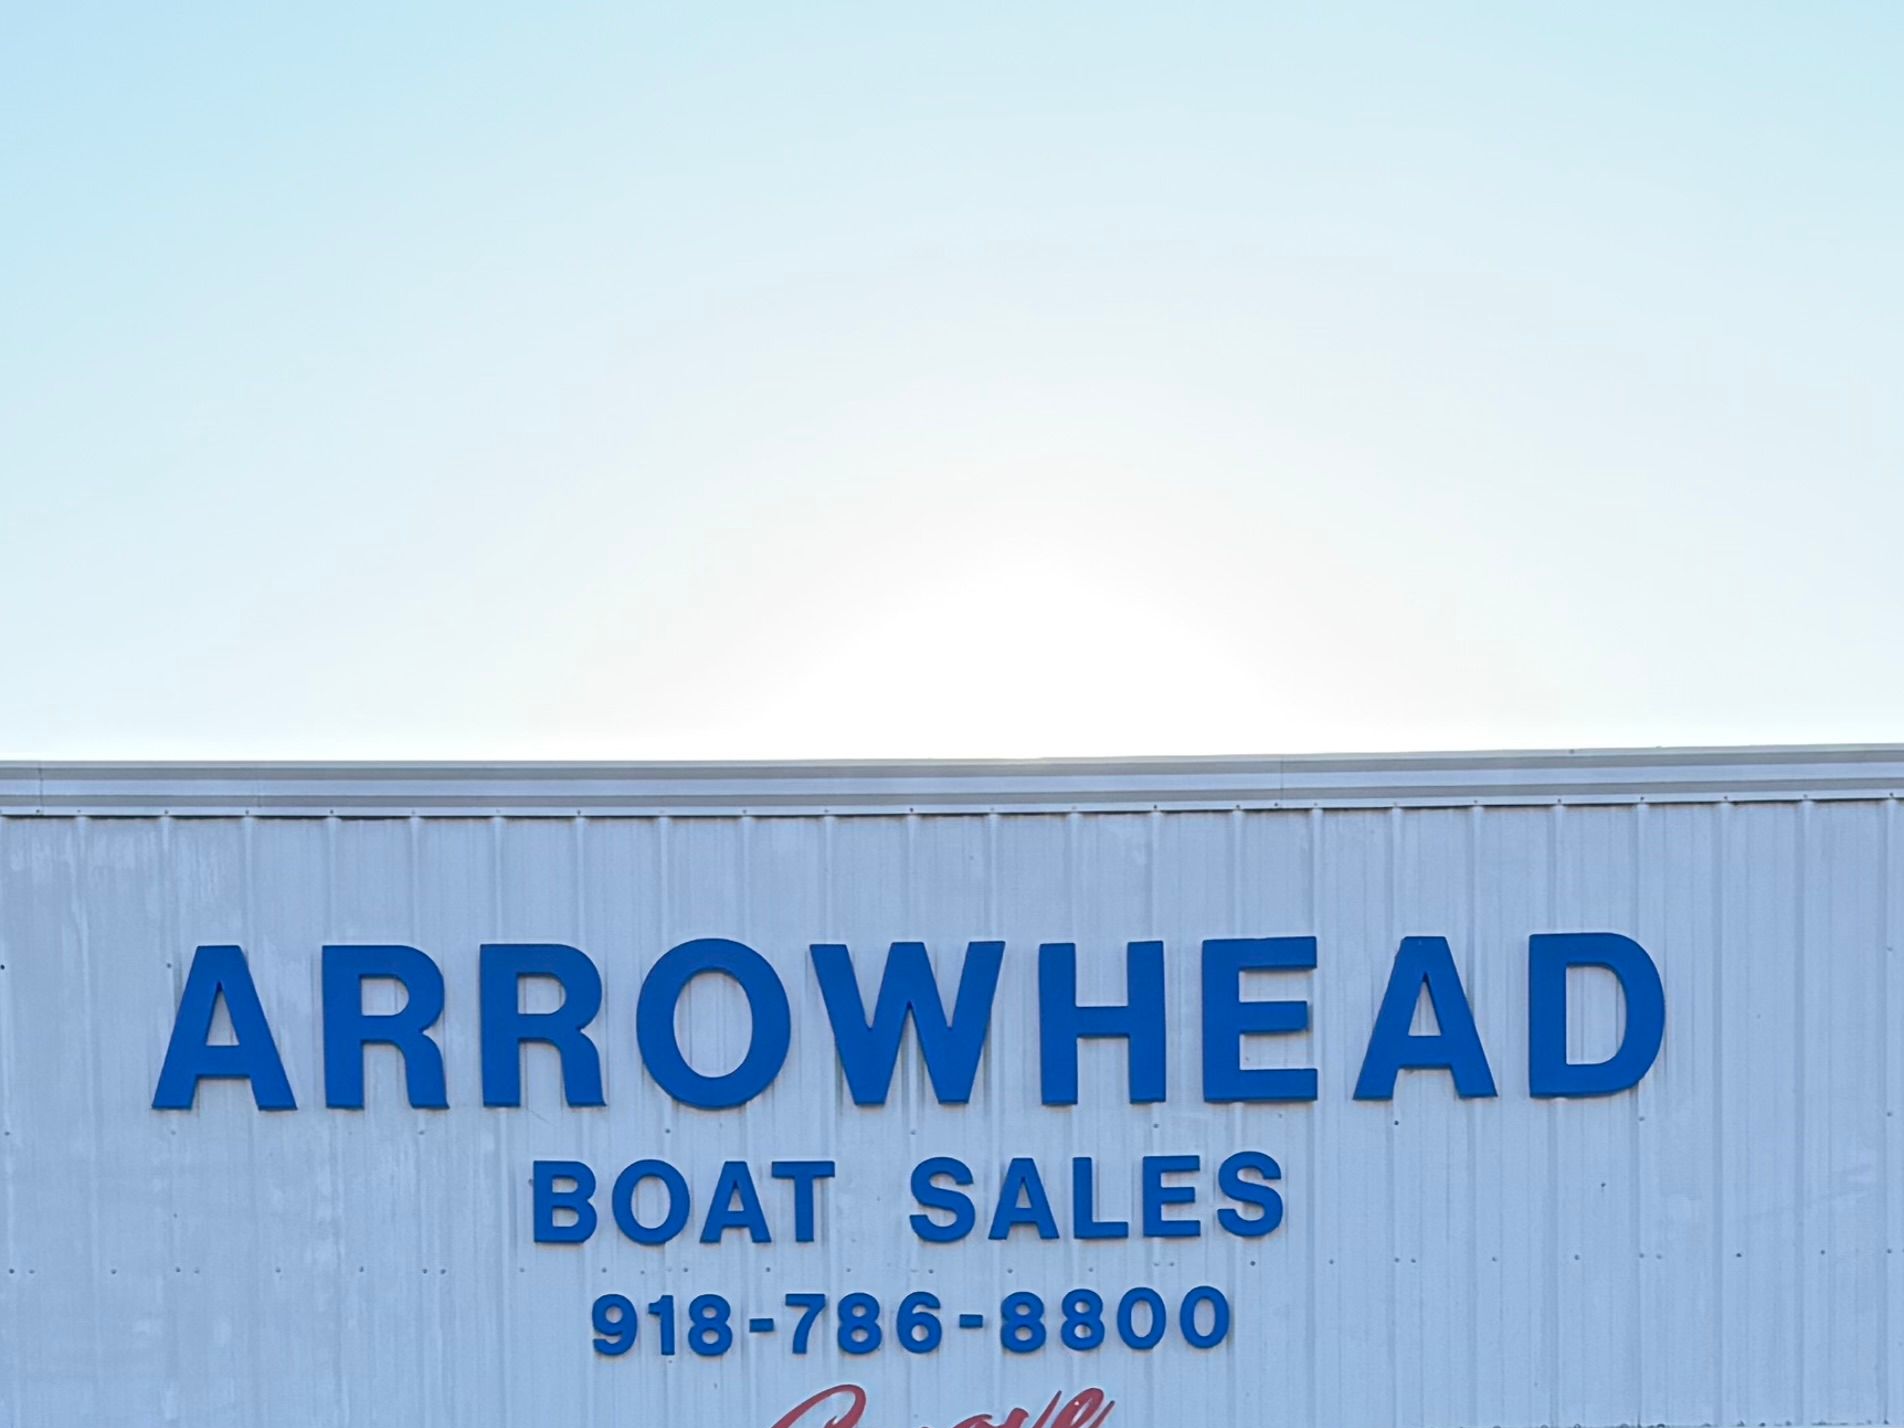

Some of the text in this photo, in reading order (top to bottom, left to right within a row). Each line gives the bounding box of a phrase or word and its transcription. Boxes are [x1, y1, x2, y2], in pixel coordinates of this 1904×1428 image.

[151, 931, 1667, 1112] ARROWHEAD
[532, 1151, 1287, 1246] BOAT SALES
[590, 1285, 1231, 1359] 918-786-8800
